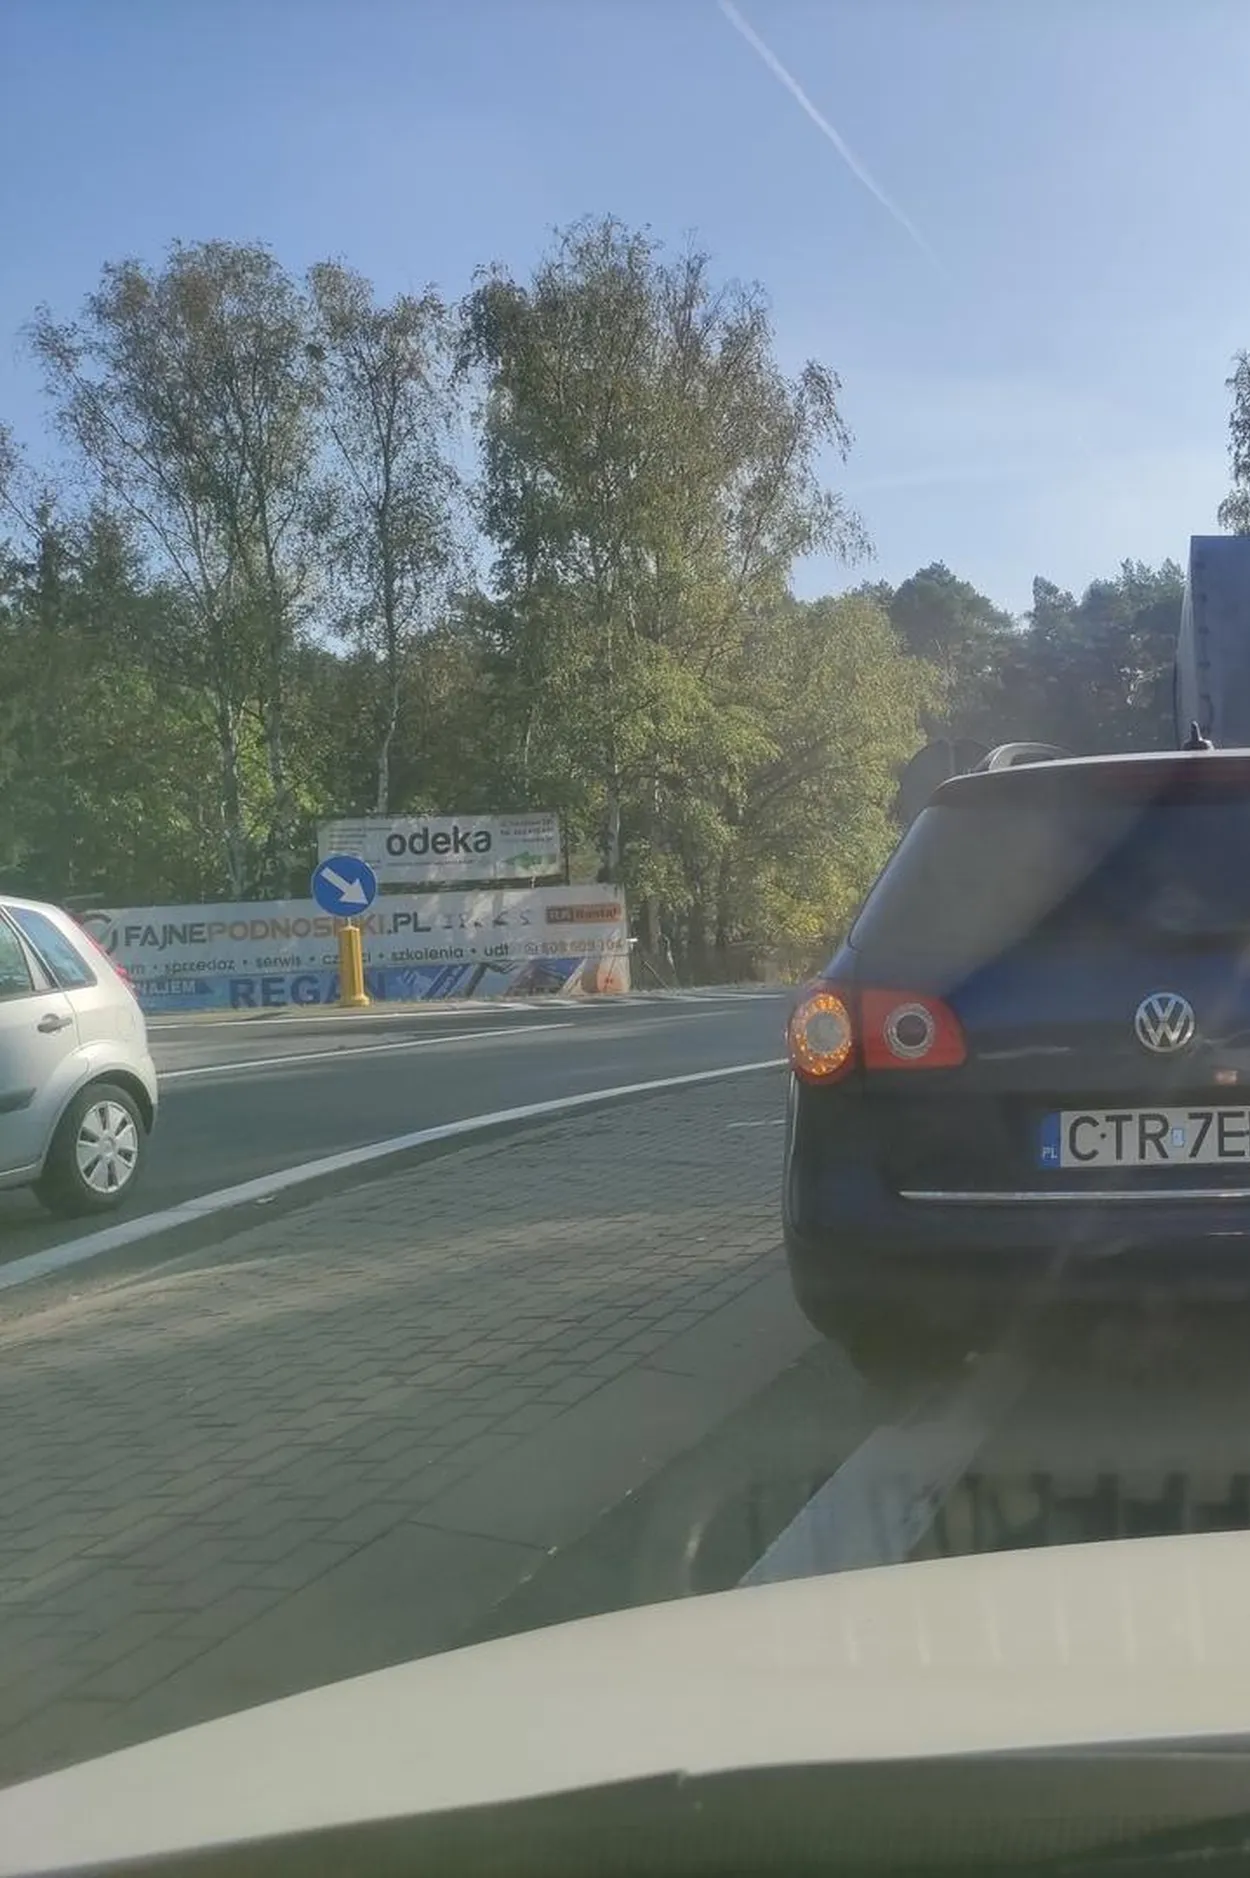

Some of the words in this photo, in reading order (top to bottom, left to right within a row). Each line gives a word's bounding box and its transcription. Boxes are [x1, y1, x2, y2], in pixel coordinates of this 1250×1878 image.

[386, 825, 492, 857] odeka
[125, 911, 431, 951] FAJNEPODNOSKI.PL
[255, 954, 302, 969] serwis
[322, 952, 371, 966] czci
[390, 946, 464, 962] szkolenia
[135, 979, 197, 996] NAJEM
[1068, 1114, 1169, 1161] CTR
